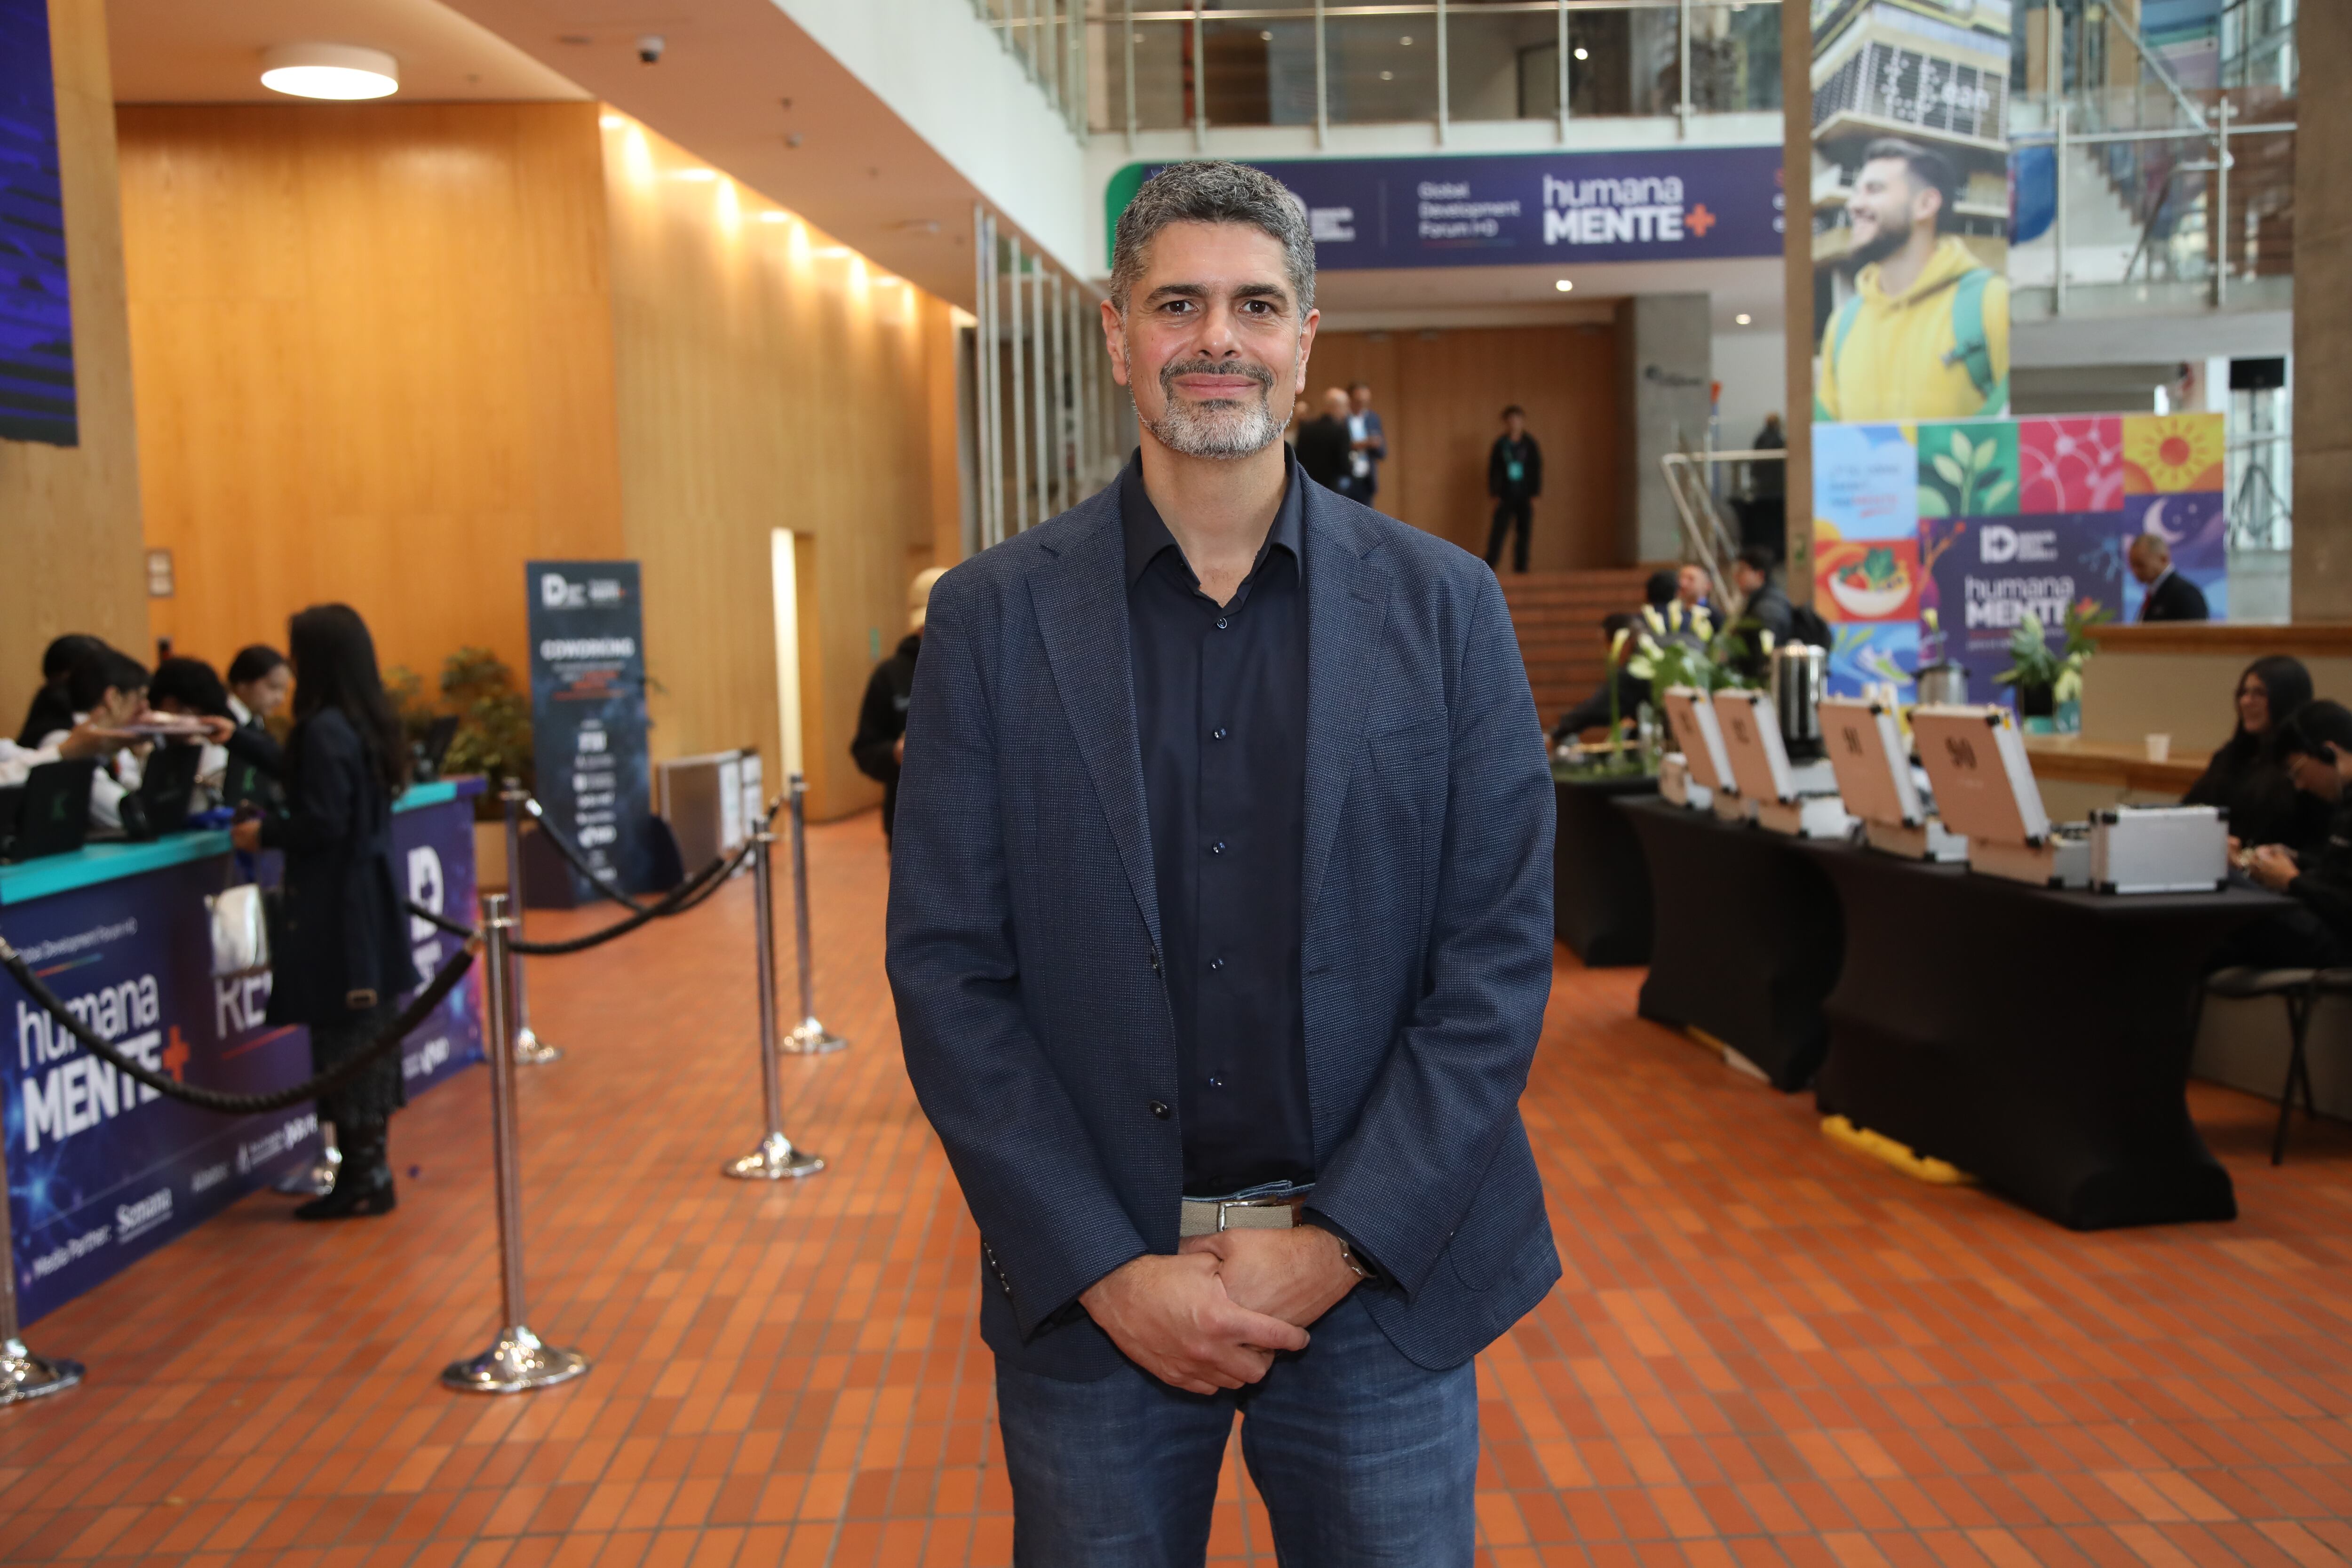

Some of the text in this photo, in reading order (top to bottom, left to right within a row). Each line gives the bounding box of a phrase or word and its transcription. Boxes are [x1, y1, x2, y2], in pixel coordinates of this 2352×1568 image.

[1418, 181, 1470, 200] Global
[1543, 174, 1684, 207] humana
[1418, 200, 1520, 219] Development
[1418, 220, 1469, 239] Forum
[1965, 575, 2075, 599] humana
